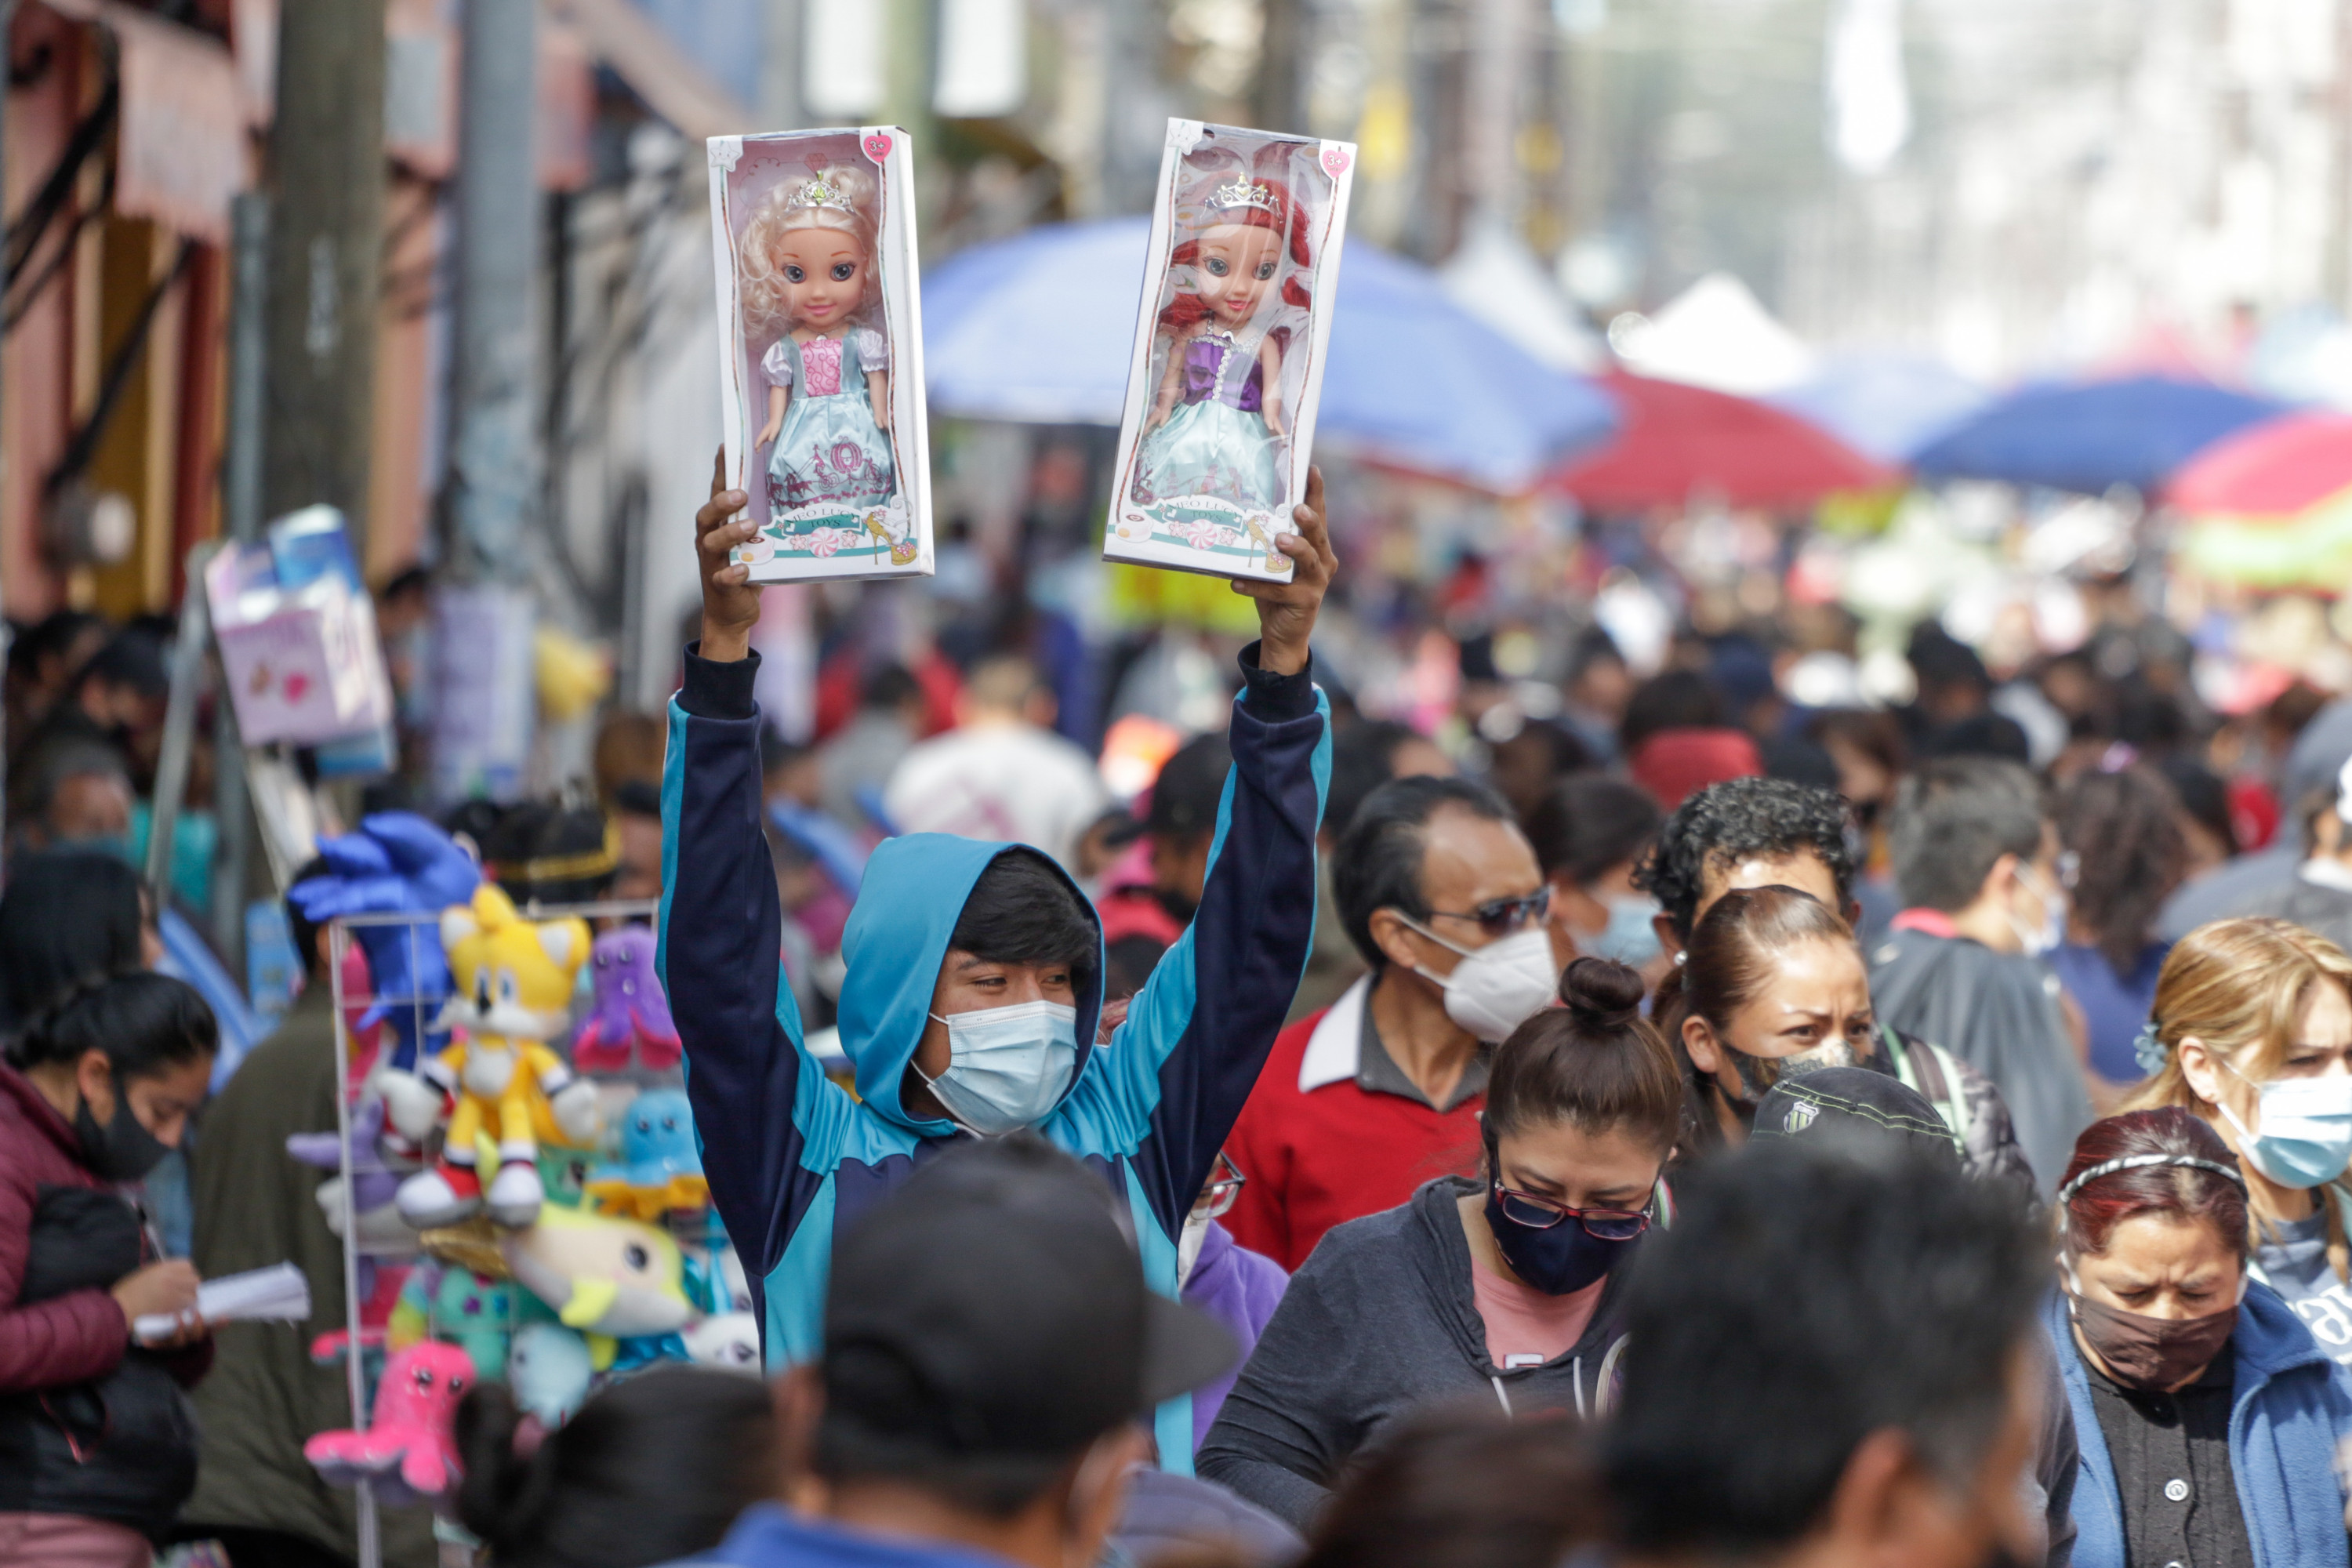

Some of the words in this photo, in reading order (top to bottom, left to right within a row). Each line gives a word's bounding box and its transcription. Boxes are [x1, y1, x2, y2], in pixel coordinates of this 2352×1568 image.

[869, 140, 885, 152] 3+
[1327, 154, 1343, 166] 3+
[822, 508, 860, 519] LUCY
[1206, 501, 1243, 517] LUCY
[1191, 510, 1223, 523] TOYS
[808, 518, 840, 528] TOYS
